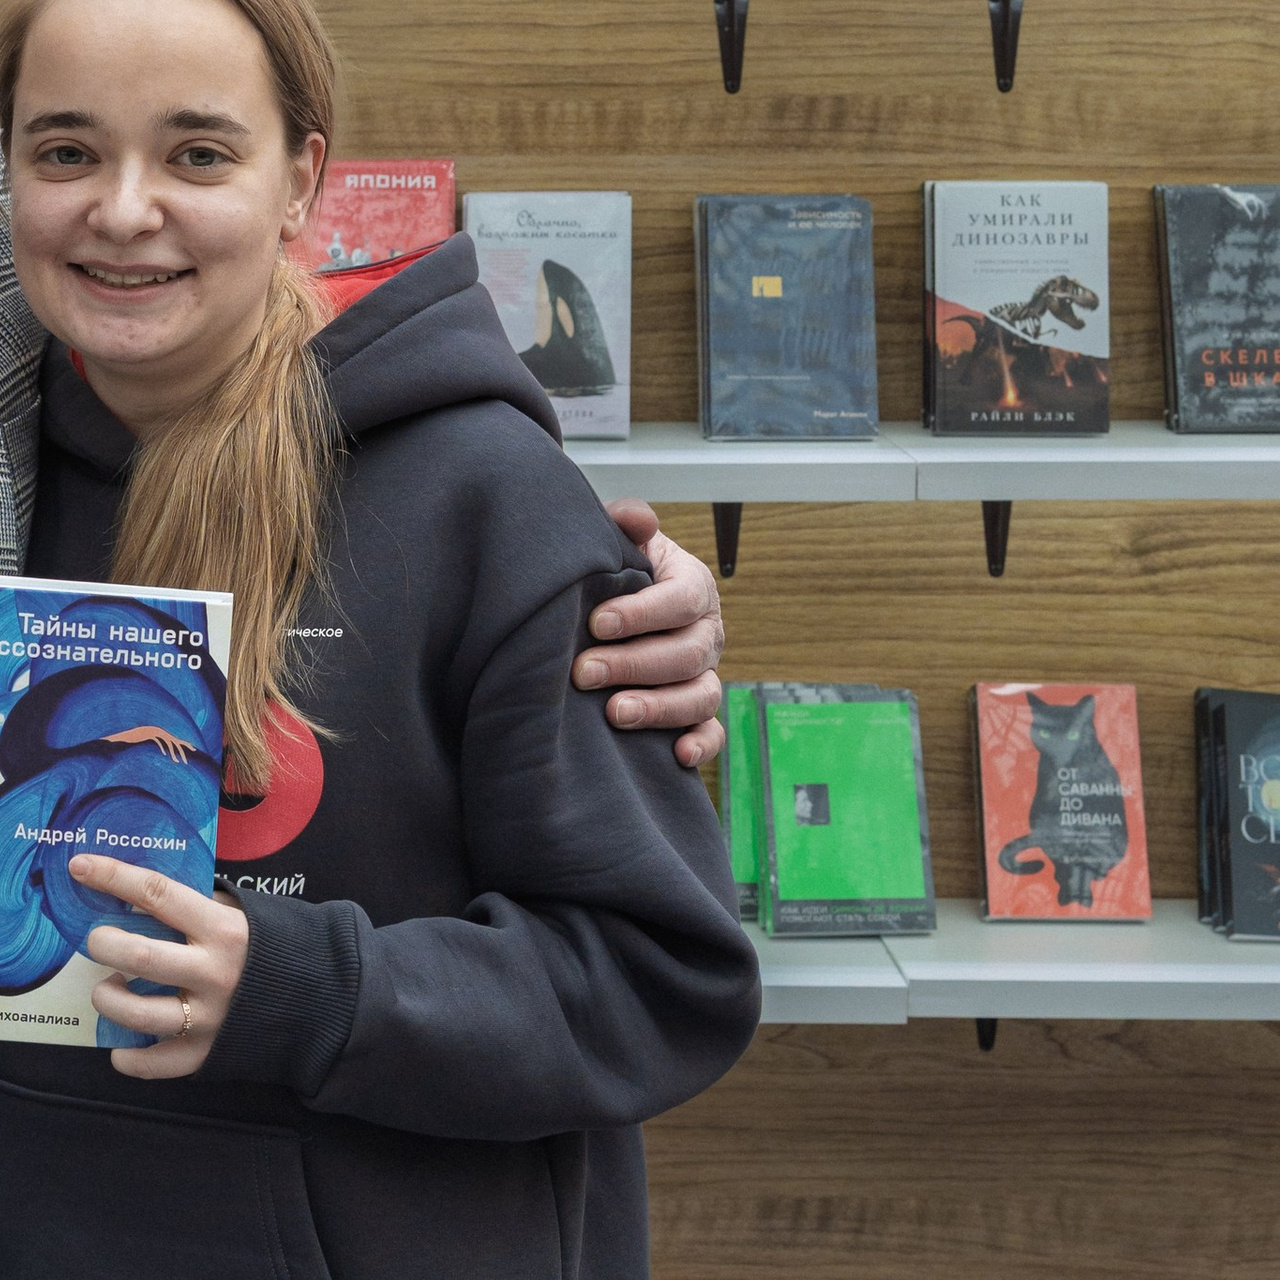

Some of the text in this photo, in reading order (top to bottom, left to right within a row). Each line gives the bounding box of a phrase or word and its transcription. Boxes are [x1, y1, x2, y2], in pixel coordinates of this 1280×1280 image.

[345, 174, 437, 190] ЯПОНИЯ
[1001, 194, 1041, 208] КАК
[969, 213, 1073, 227] УМИРАЛИ
[952, 231, 1090, 248] ДИНОЗАВРЫ
[19, 613, 204, 647] Тайны нашего
[1057, 768, 1078, 781] ОТ
[1058, 782, 1133, 796] САВАННЫ
[1059, 797, 1083, 811] ДО
[1060, 812, 1122, 826] ДИВАНА
[14, 823, 187, 851] Андрей Россохин
